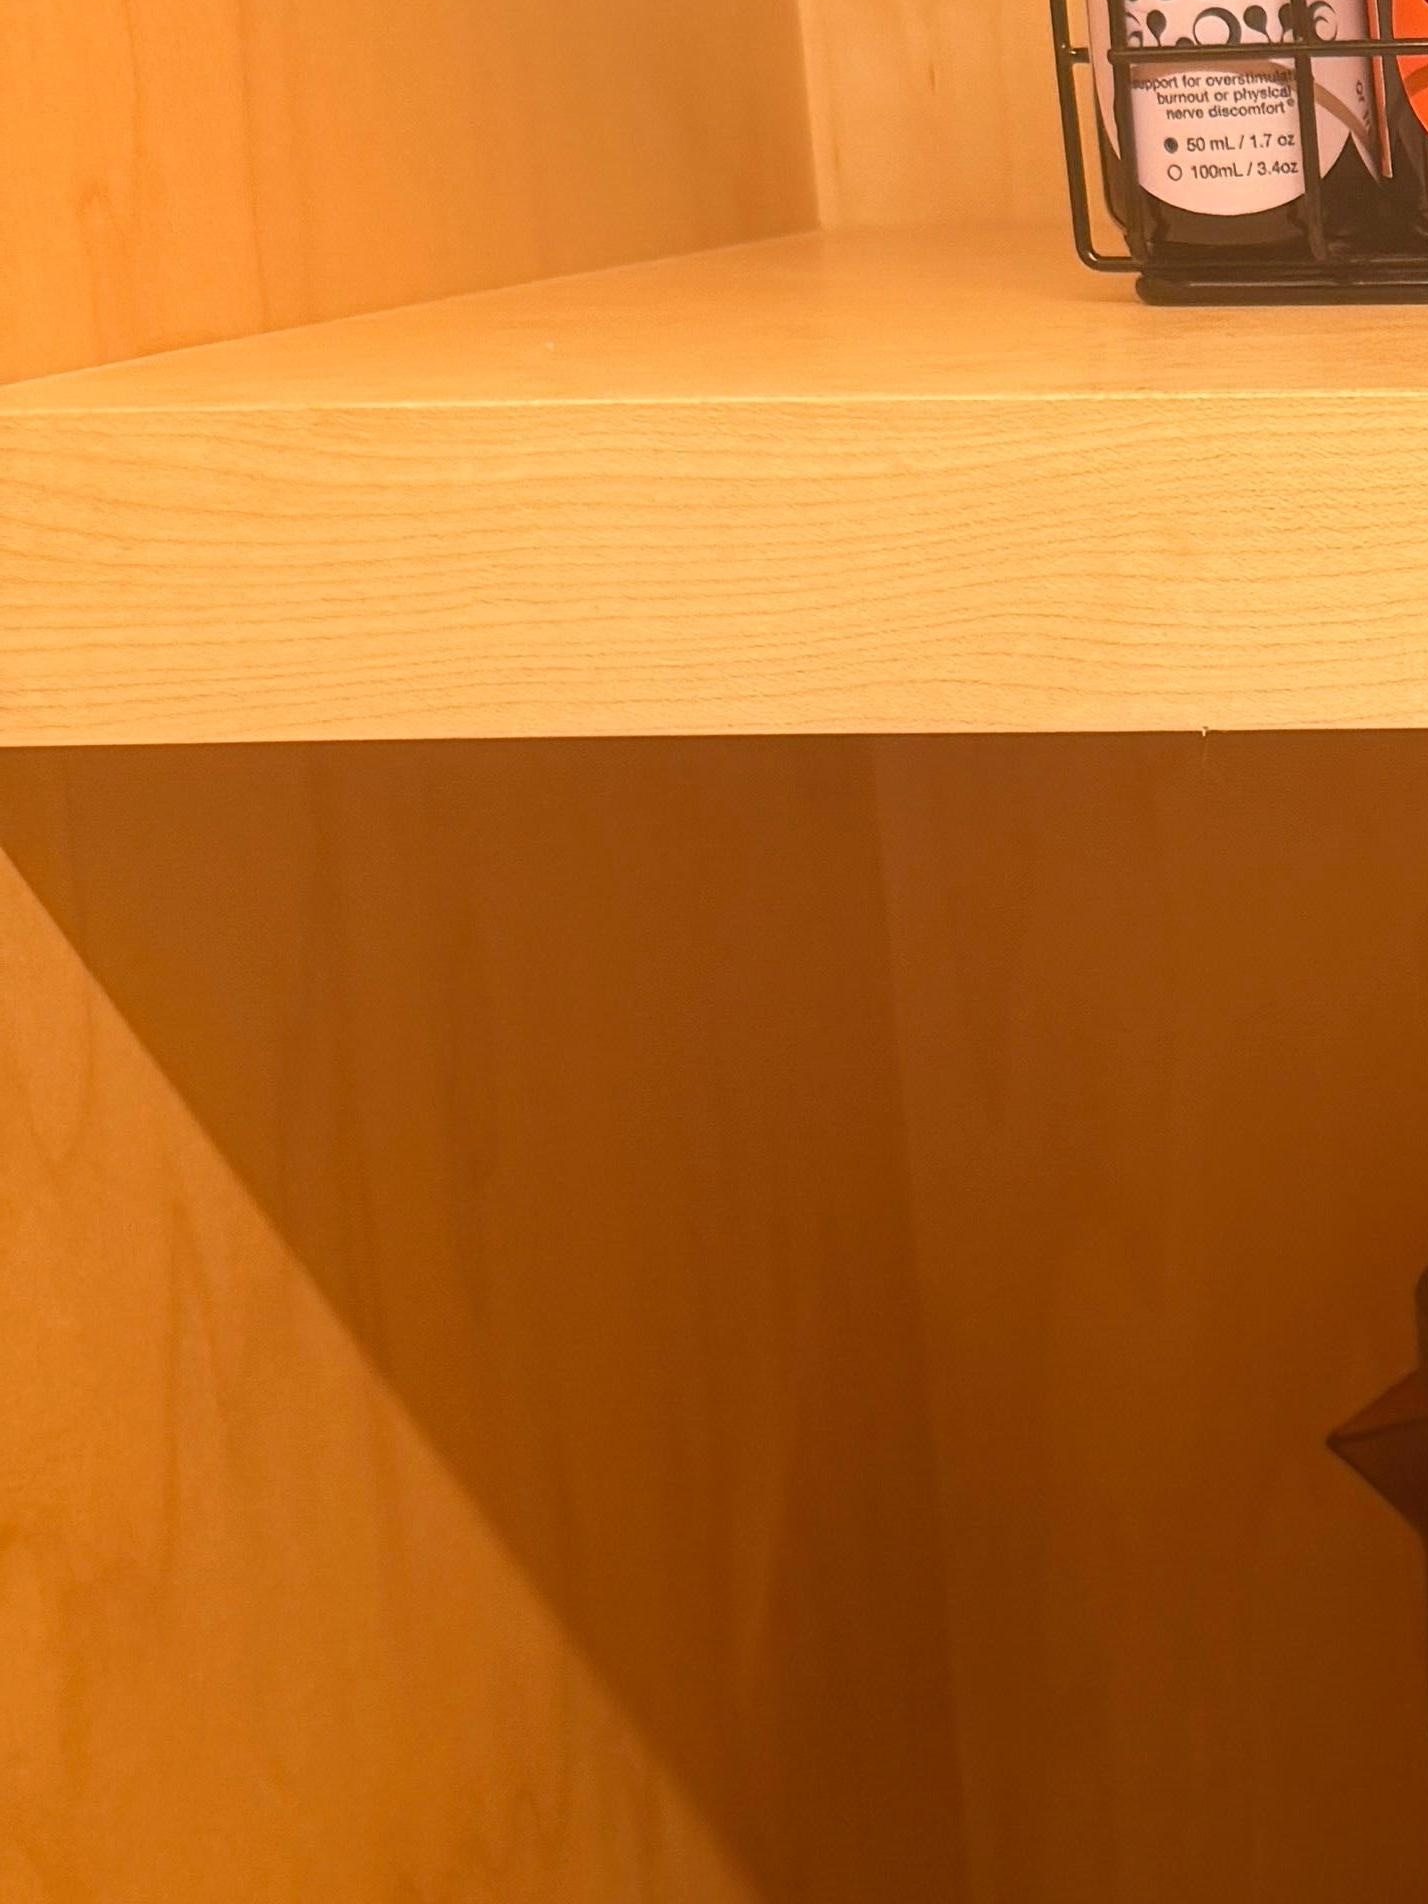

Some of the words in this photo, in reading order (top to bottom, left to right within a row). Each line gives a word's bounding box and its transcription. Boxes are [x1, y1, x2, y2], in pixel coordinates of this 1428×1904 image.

[1131, 75, 1179, 93] support
[1182, 74, 1203, 88] for
[1156, 89, 1210, 106] burnout
[1214, 92, 1230, 104] or
[1233, 85, 1293, 107] physical
[1166, 107, 1205, 121] nerve
[1186, 137, 1208, 153] 50
[1210, 136, 1236, 152] mL
[1250, 133, 1273, 150] 1.7
[1278, 133, 1297, 148] oz
[1190, 162, 1245, 180] 100mL
[1257, 160, 1300, 177] 3.4oz
